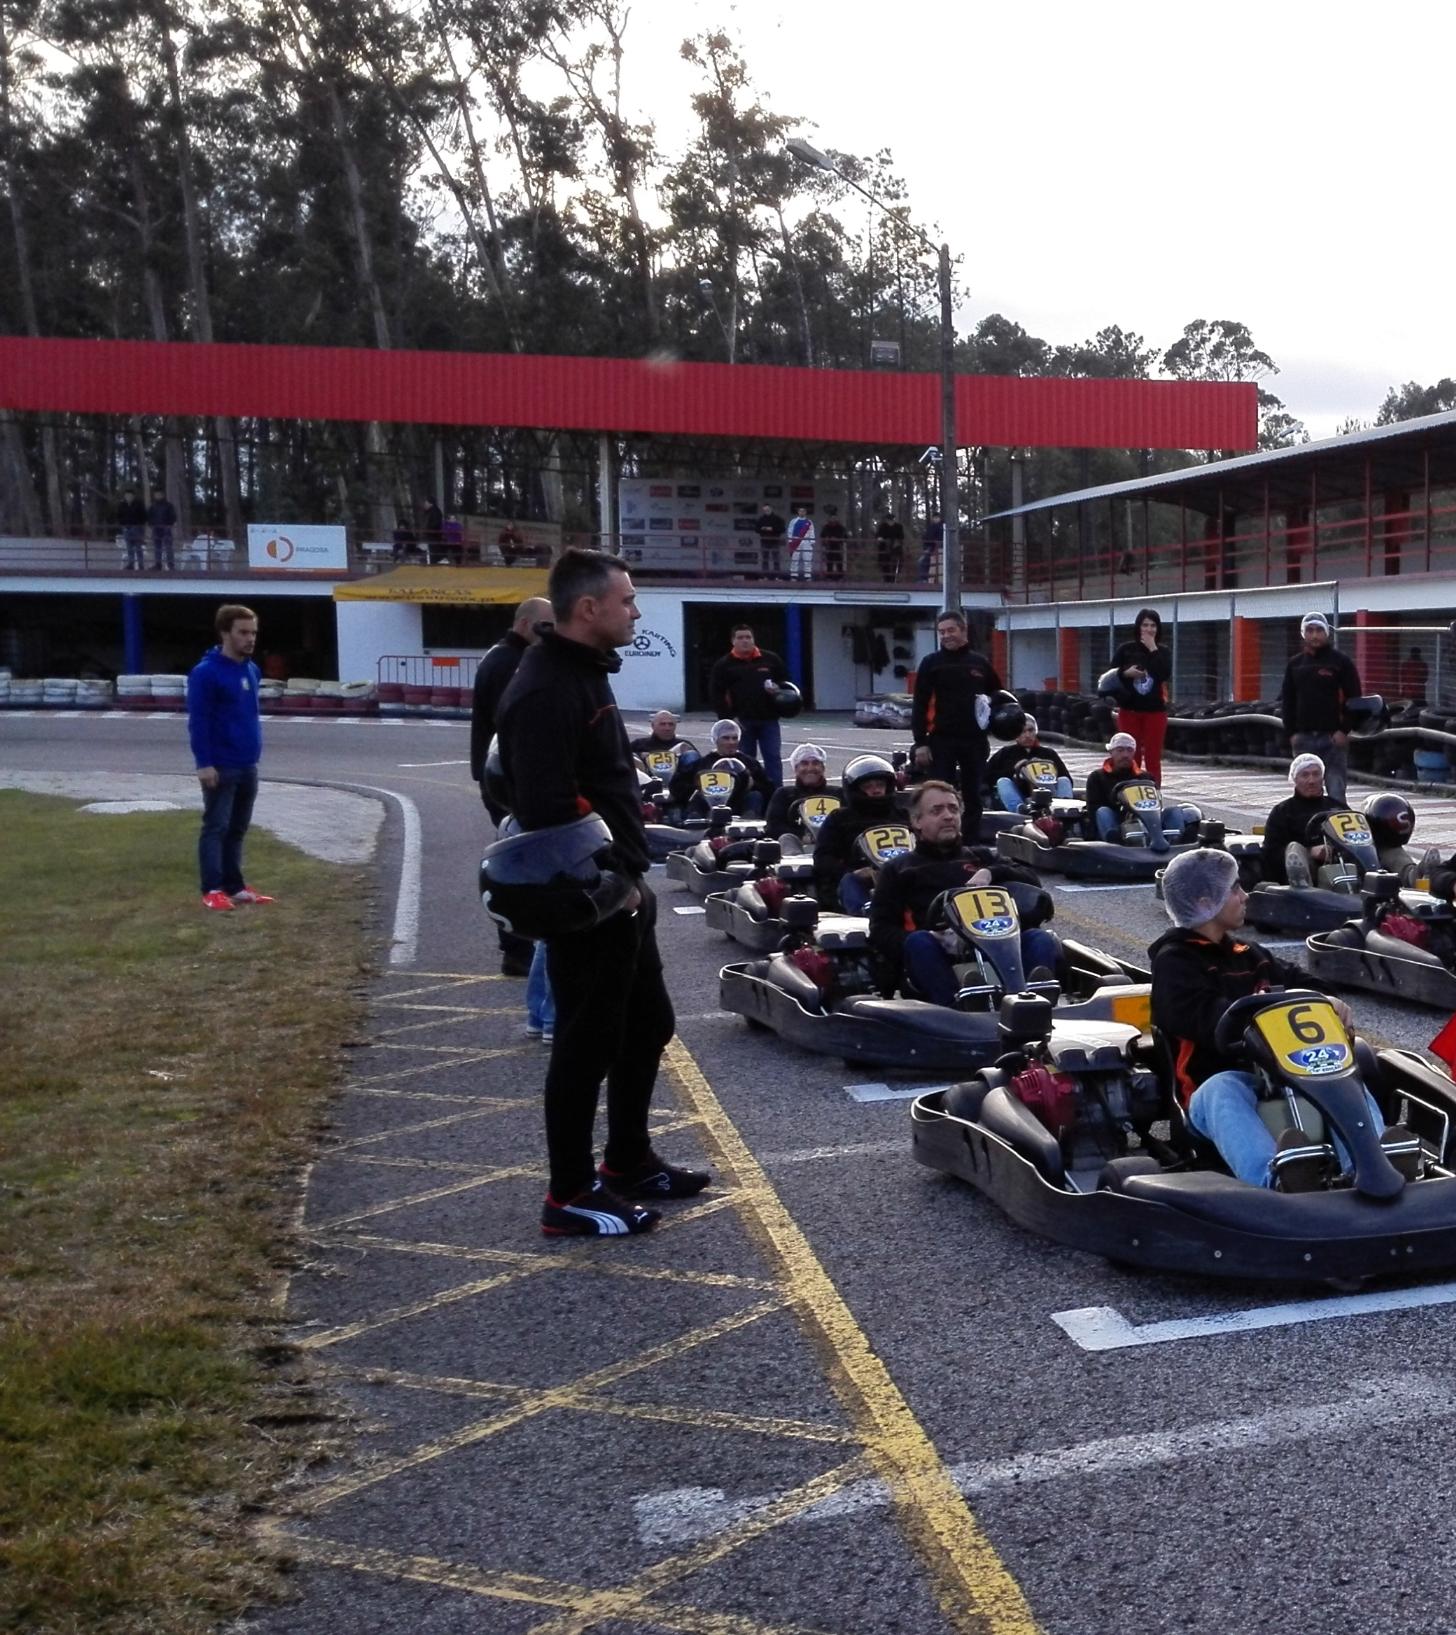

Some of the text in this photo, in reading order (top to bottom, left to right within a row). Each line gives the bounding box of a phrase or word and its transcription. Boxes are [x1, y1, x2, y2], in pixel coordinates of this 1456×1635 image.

[654, 753, 673, 764] 25
[1031, 763, 1051, 775] 12
[707, 774, 719, 786] 3
[1137, 786, 1157, 800] 18
[815, 799, 827, 815] 4
[1336, 814, 1370, 832] 29
[872, 829, 910, 850] 22
[972, 892, 1011, 920] 13
[1287, 1005, 1326, 1045] 6
[1306, 1049, 1330, 1063] 24
